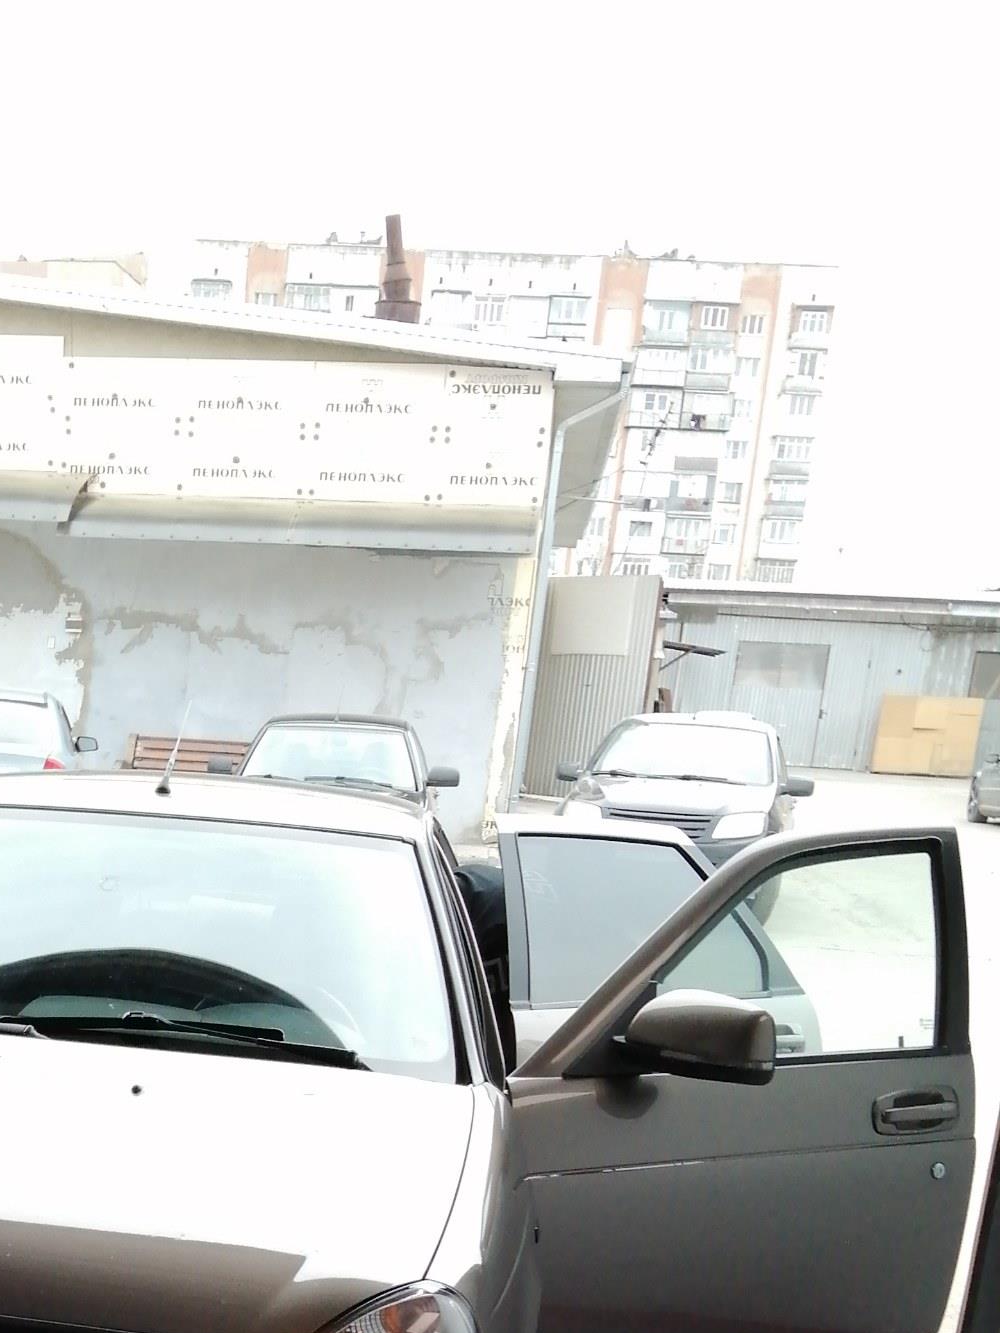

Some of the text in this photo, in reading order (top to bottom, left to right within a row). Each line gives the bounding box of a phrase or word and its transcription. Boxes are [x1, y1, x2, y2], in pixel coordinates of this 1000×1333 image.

[451, 383, 543, 396] ПЕНОПЛЭКС
[198, 399, 283, 411] ПЕНОПЛЭКС
[325, 402, 412, 414] ПЕНОПЛЭКС
[192, 467, 276, 479] ПЕНОПЛЭКС
[319, 471, 405, 483] ПЕНОПЛЭКС
[449, 475, 538, 487] ПЕНОПЛЭКС
